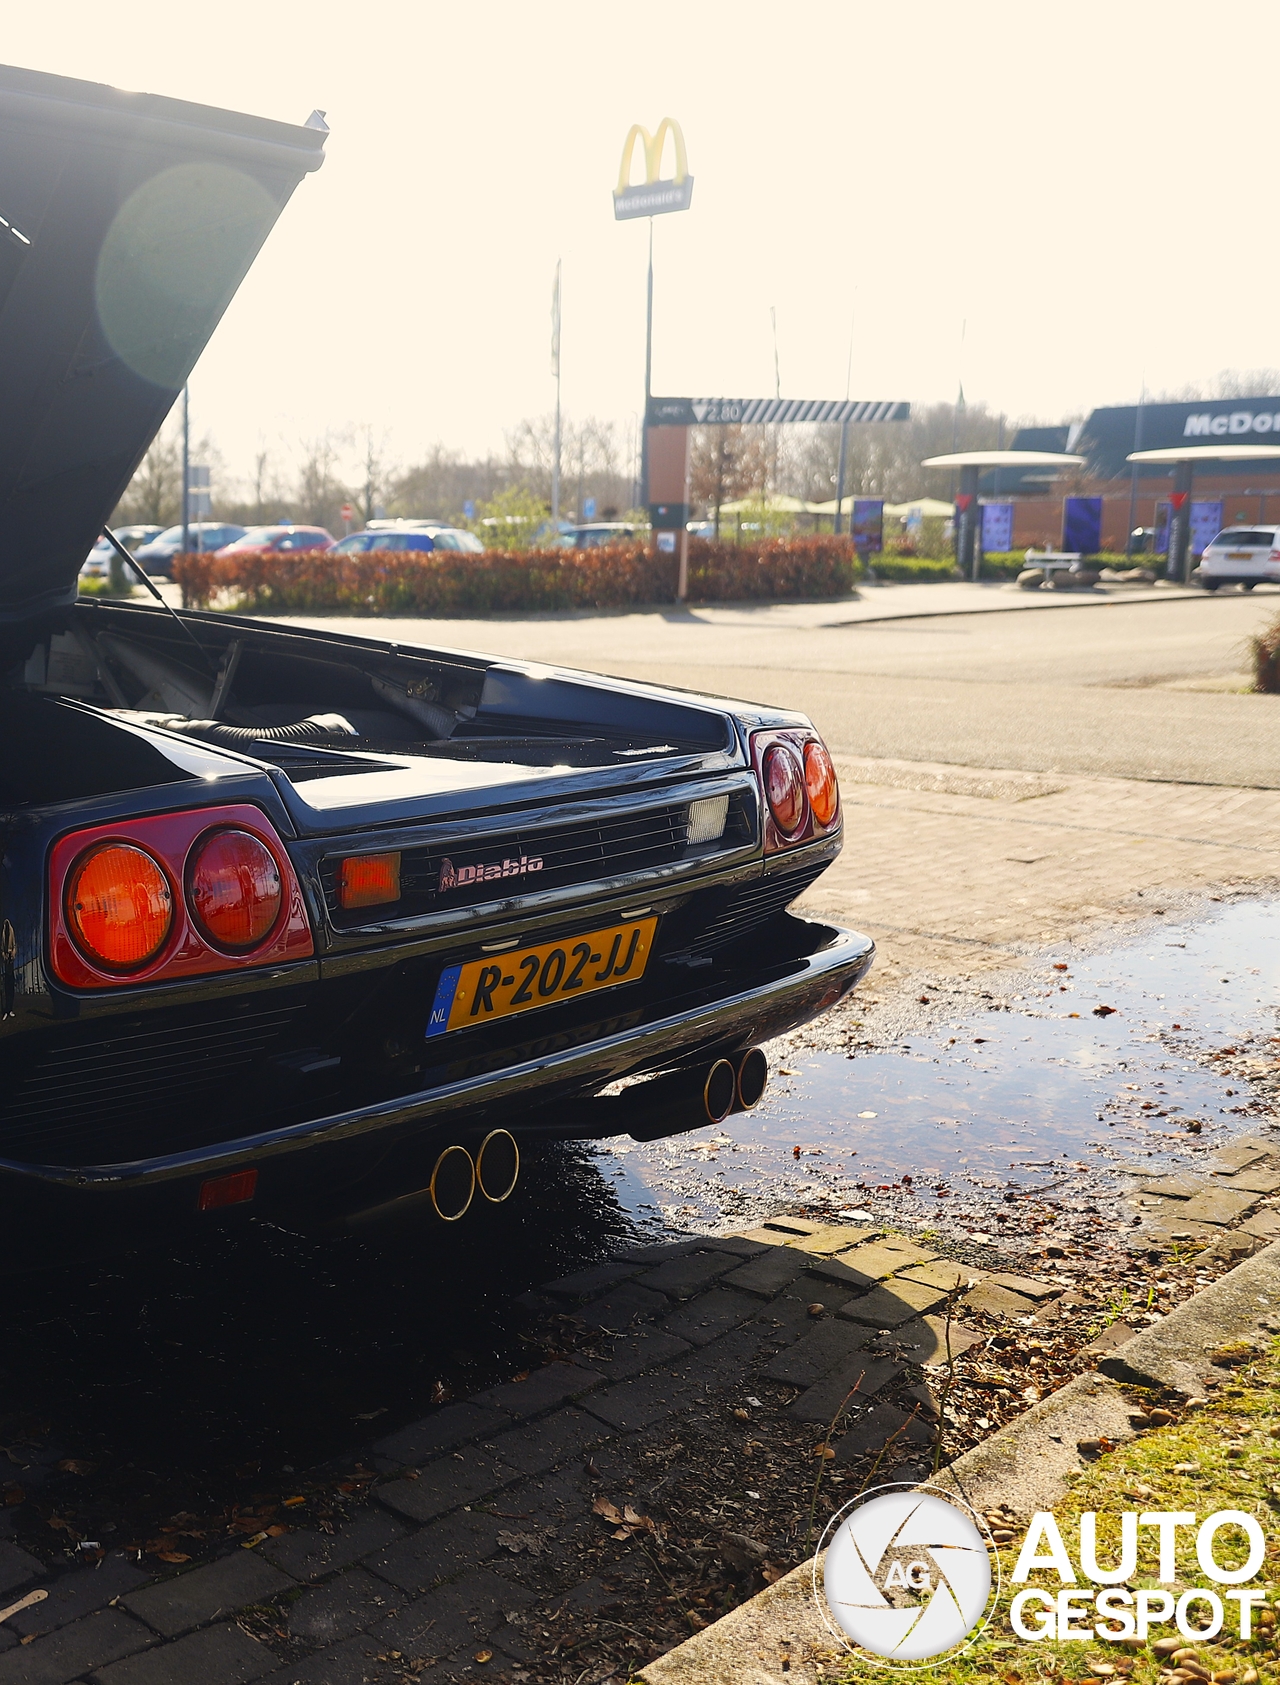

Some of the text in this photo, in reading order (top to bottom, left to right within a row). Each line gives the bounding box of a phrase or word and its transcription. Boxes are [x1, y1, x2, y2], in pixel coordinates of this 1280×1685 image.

[706, 402, 740, 422] 2.80
[457, 855, 544, 886] Diablo
[470, 928, 641, 1017] R-202-JJ
[429, 1007, 446, 1025] NL
